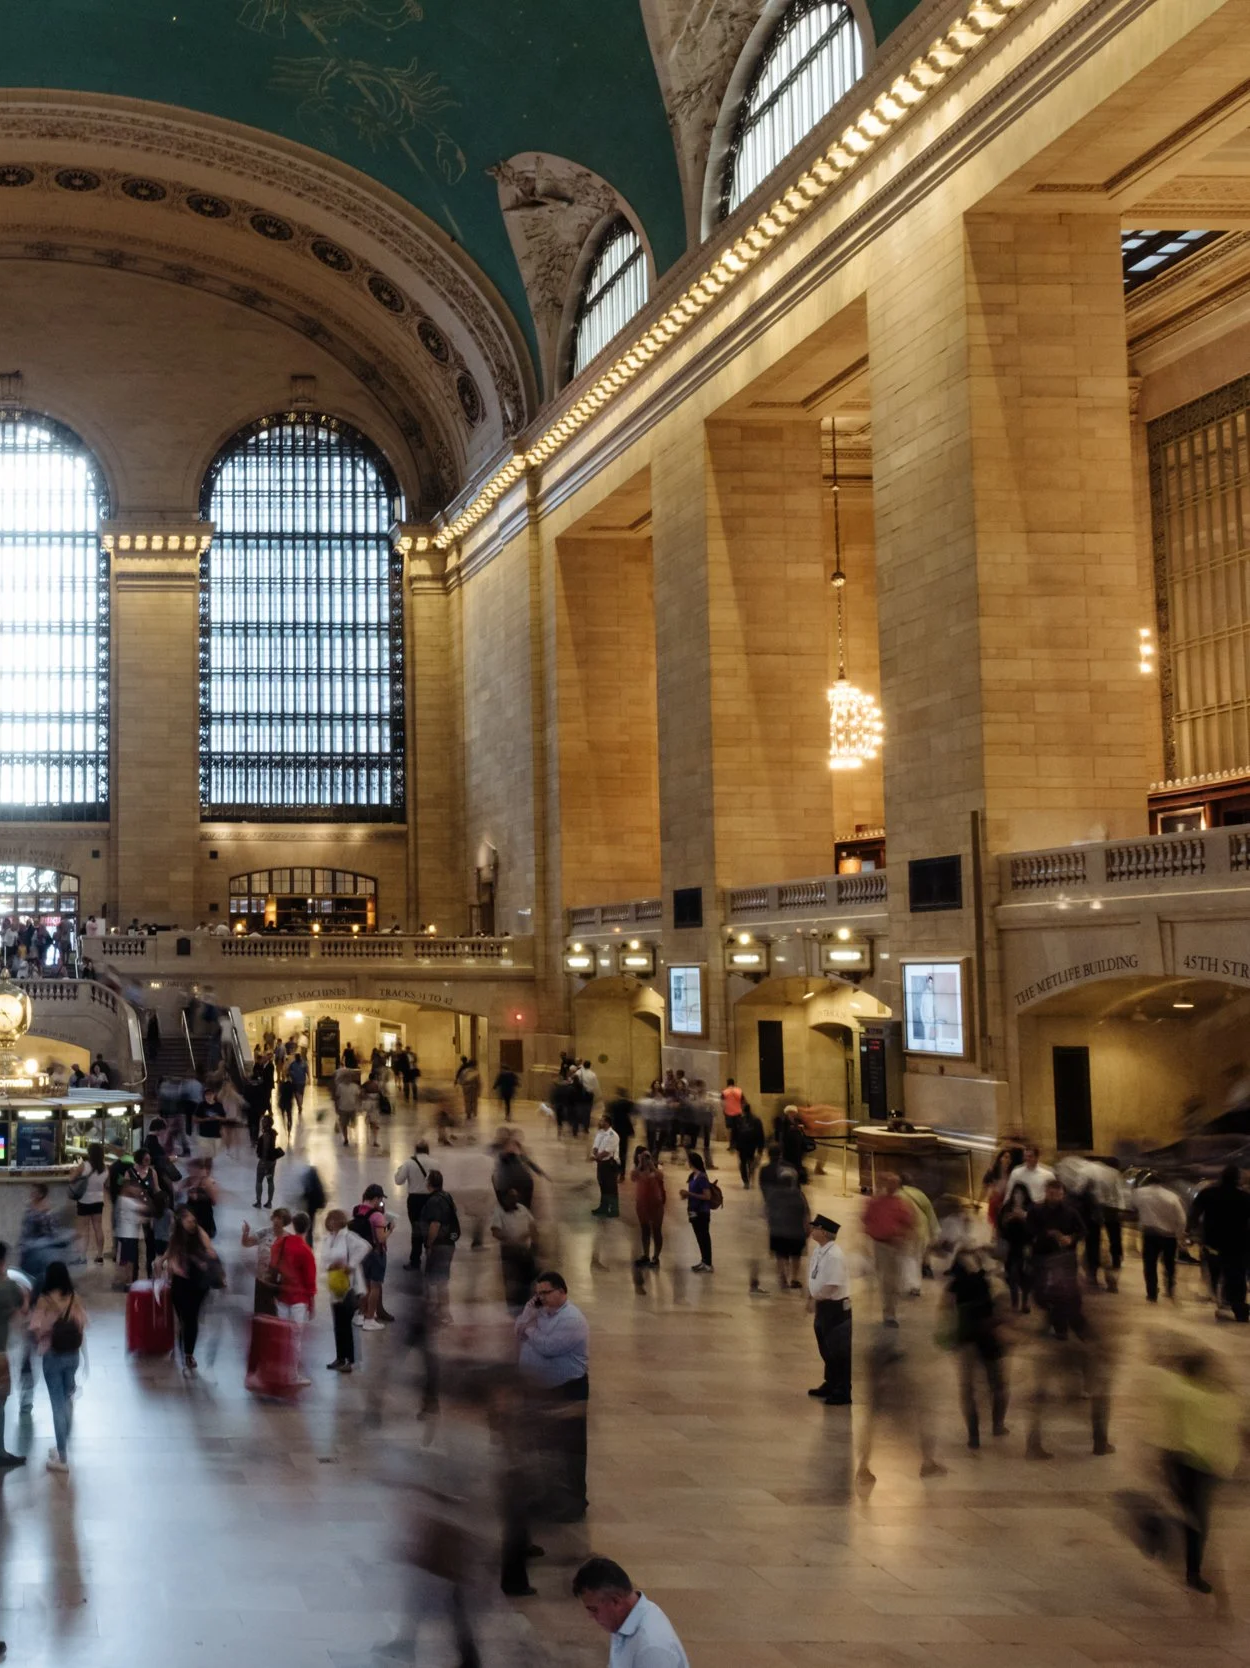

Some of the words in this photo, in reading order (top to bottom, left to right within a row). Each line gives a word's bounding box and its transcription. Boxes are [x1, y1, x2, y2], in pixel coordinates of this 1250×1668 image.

[1183, 955, 1219, 973] 45TH
[1014, 985, 1036, 1006] THE
[1036, 966, 1082, 994] METLIFE
[1082, 954, 1139, 977] BUILDING
[263, 993, 294, 1005] TICKET
[298, 987, 347, 999] MACHINES
[379, 988, 416, 1000] TRACKS
[428, 994, 442, 1003] TO
[318, 1002, 354, 1011] WAITING
